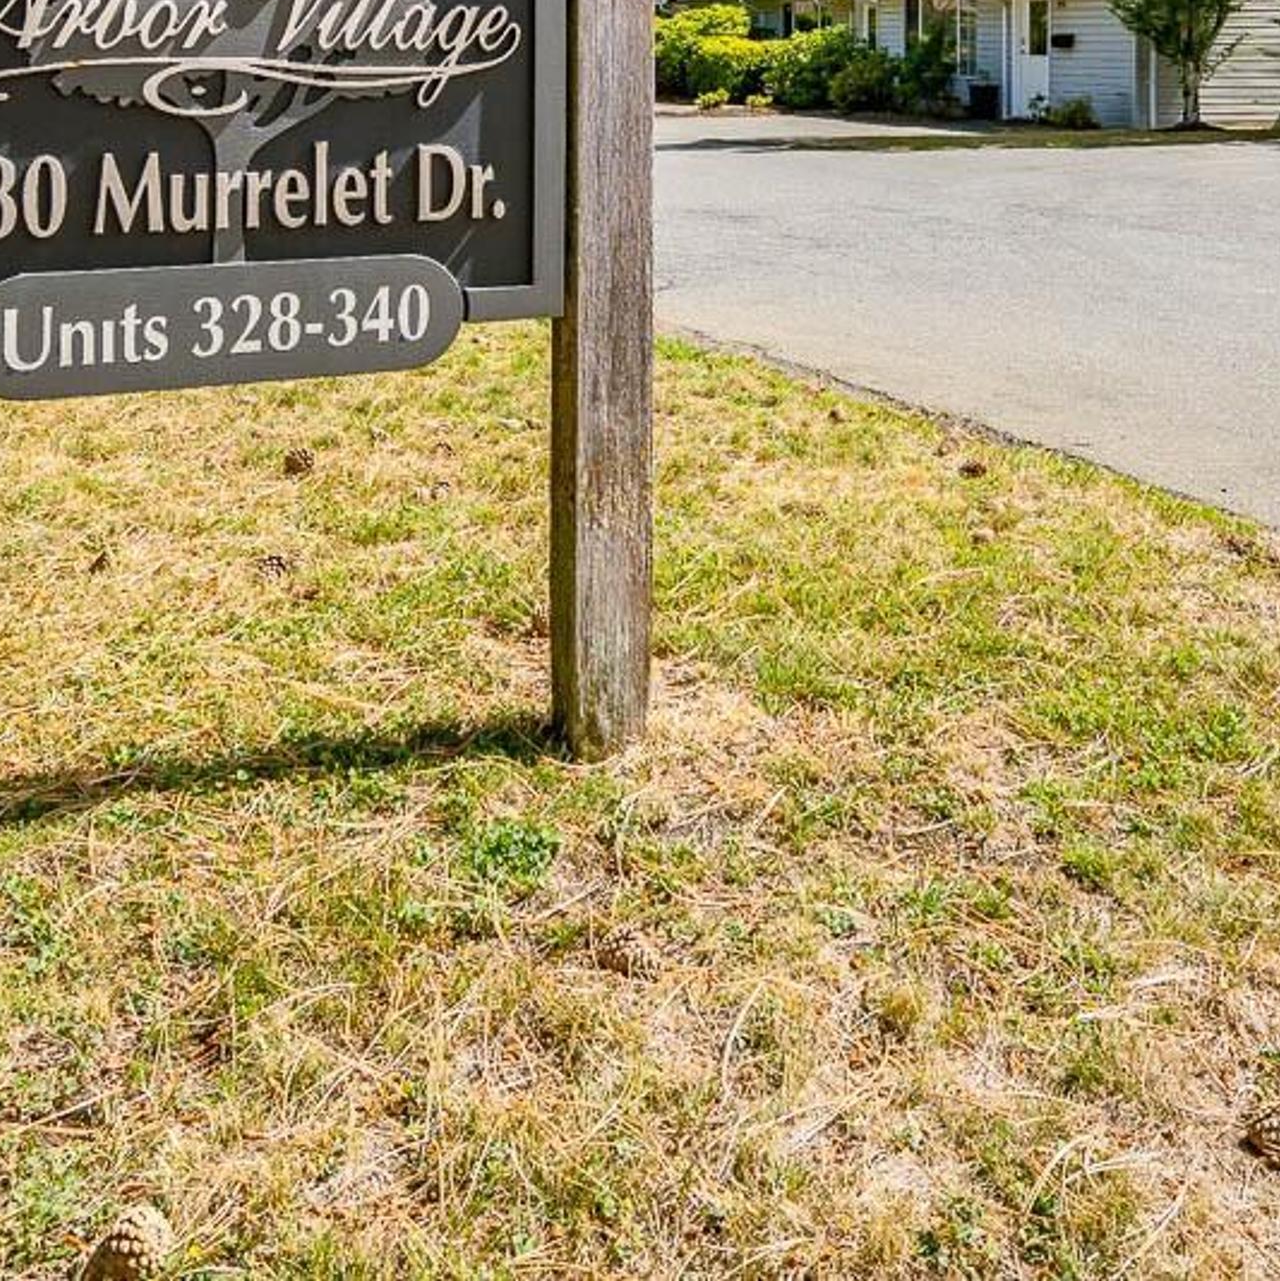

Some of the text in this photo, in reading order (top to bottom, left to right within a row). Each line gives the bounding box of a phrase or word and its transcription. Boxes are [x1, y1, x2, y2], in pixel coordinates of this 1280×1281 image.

[94, 142, 392, 235] Murrelet
[417, 143, 506, 222] Dr.
[2, 283, 430, 372] Units 328-340
